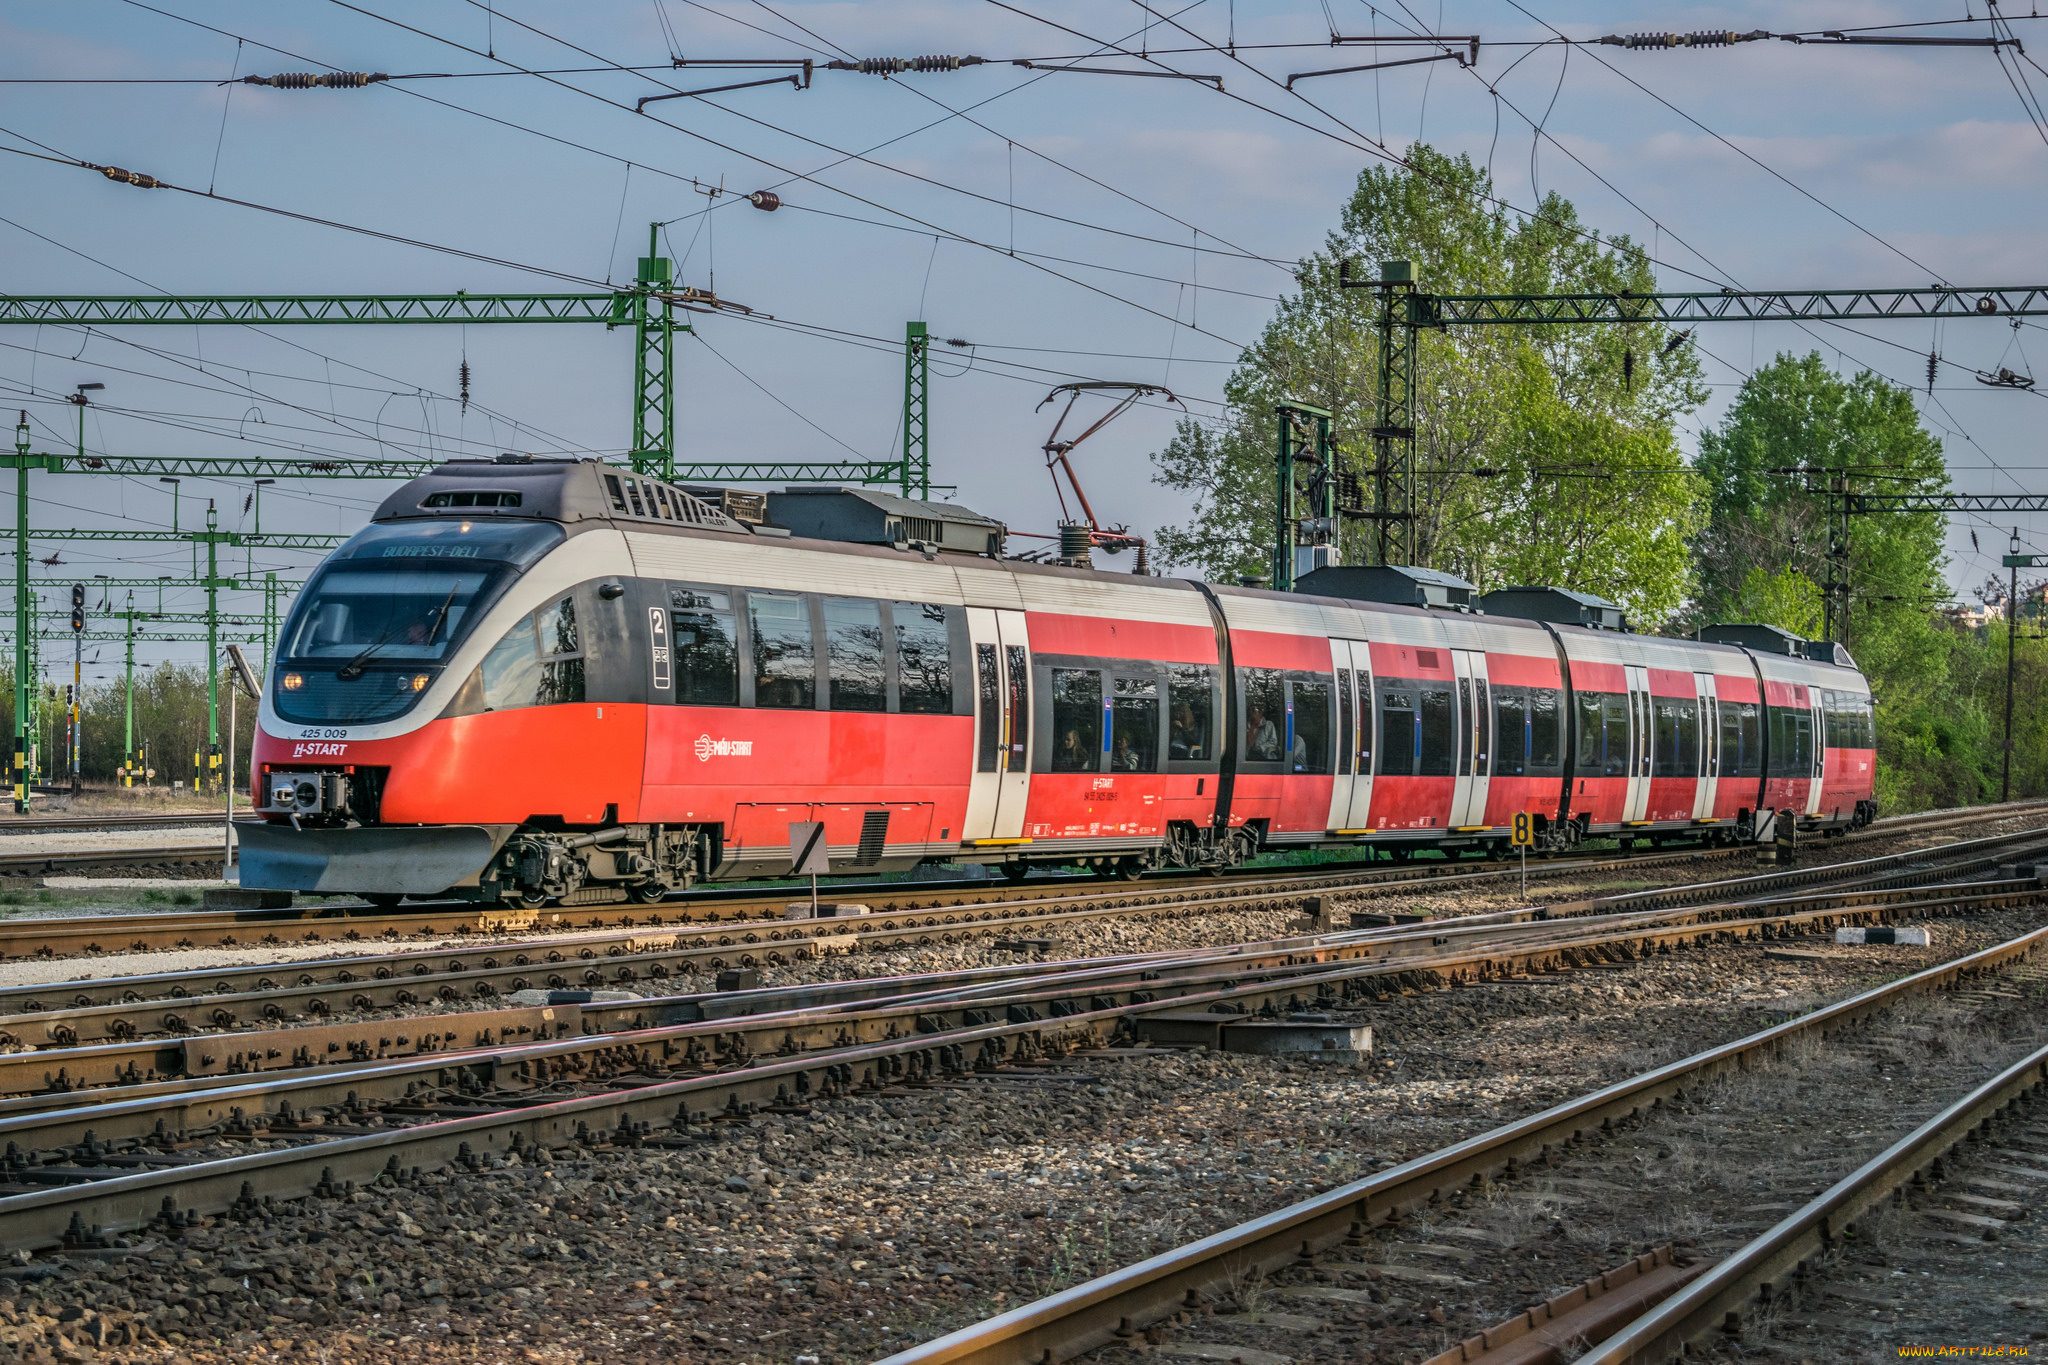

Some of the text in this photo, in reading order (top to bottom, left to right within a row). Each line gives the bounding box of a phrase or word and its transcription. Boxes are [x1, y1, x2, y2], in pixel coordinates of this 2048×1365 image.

[704, 518, 728, 527] TALENT
[652, 610, 664, 634] 2
[300, 729, 347, 739] 425 009
[292, 742, 348, 757] H-START
[1515, 813, 1528, 843] 8
